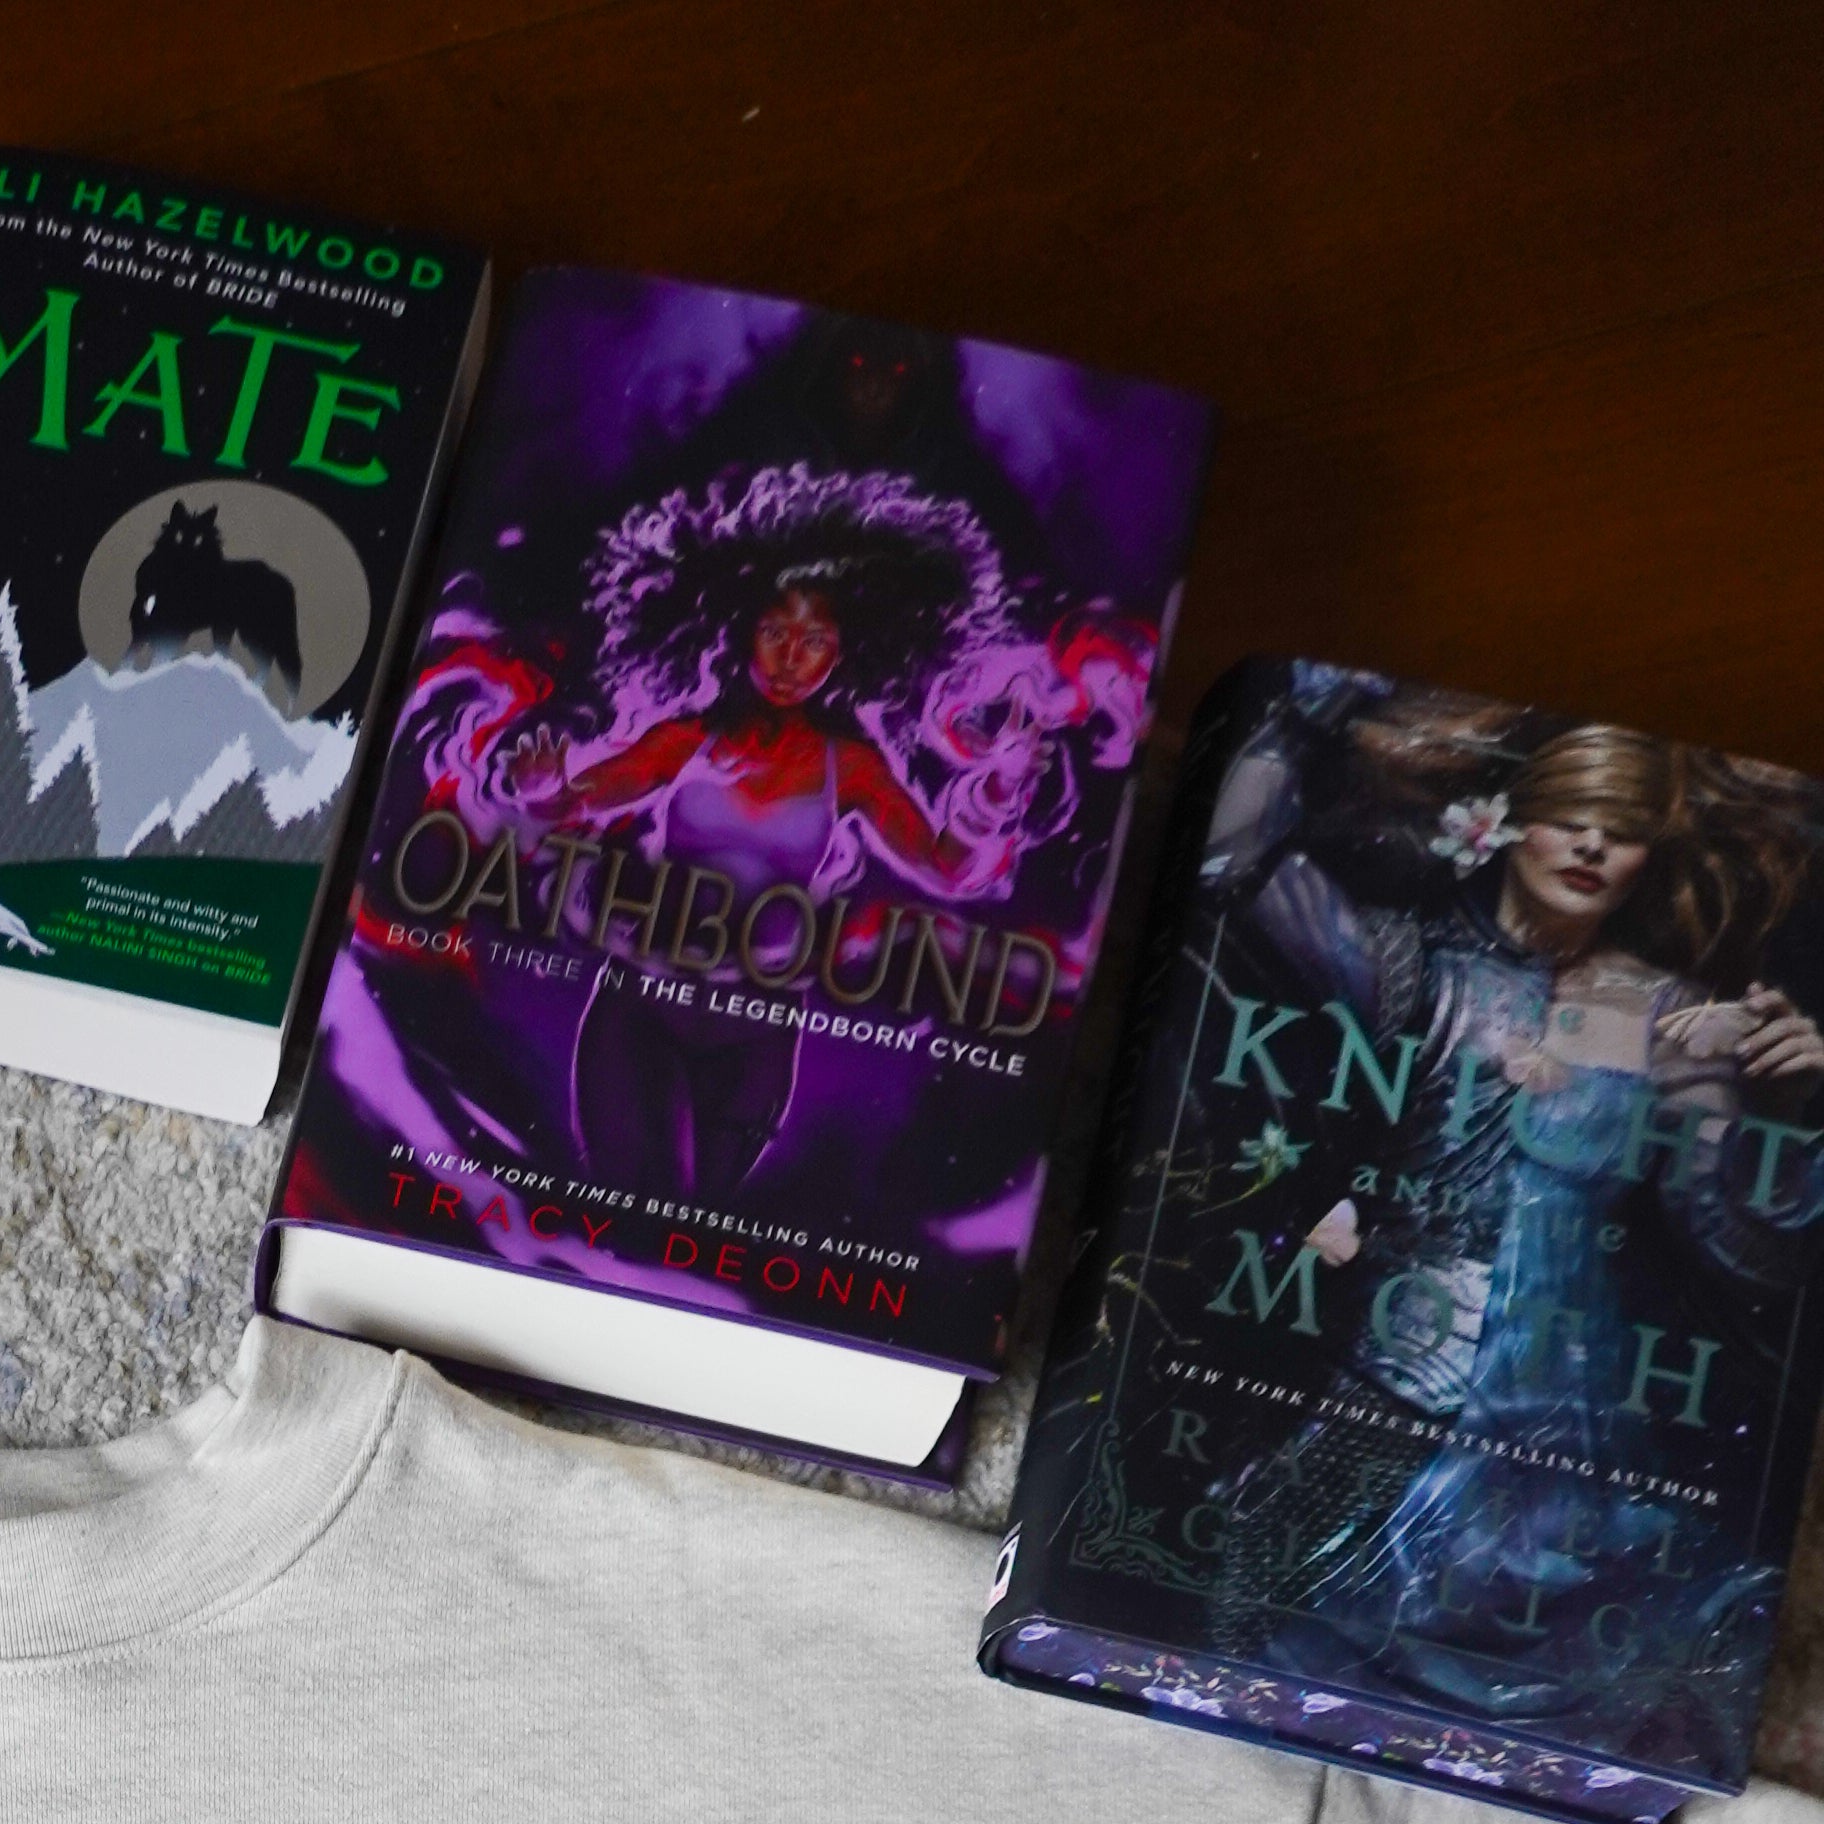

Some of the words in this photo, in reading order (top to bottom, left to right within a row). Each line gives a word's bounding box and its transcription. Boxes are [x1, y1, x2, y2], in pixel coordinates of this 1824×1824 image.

[37, 219, 71, 238] the
[83, 227, 133, 250] New
[146, 240, 192, 264] York
[206, 253, 268, 281] Times
[276, 270, 405, 317] Bestselling
[72, 181, 443, 288] HAZELWOOD
[84, 252, 162, 281] Author
[174, 274, 197, 289] of
[207, 280, 277, 307] BRIDE
[86, 898, 131, 915] primal
[134, 906, 145, 920] in
[150, 911, 165, 923] its
[104, 918, 137, 936] York
[141, 927, 184, 948] Times
[164, 899, 190, 912] and
[194, 905, 228, 924] witty
[232, 915, 258, 928] and
[391, 809, 1060, 1038] OATHBOUND
[384, 919, 474, 961] BOOK
[485, 939, 584, 981] THREE
[592, 964, 627, 990] IN
[641, 973, 695, 1005] THE
[708, 988, 918, 1054] LEGENDBORN
[929, 1038, 1025, 1075] CYCLE
[388, 1174, 613, 1251] TRACY
[661, 1233, 906, 1317] DEONN
[391, 1144, 417, 1161] #1
[424, 1149, 481, 1177] NEW
[490, 1165, 554, 1190] YORK
[567, 1181, 635, 1208] TIMES
[646, 1199, 807, 1246] BESTSELLING
[819, 1238, 919, 1270] AUTHOR
[1167, 1361, 1222, 1384] NEW
[1237, 1378, 1304, 1405] YORK
[1407, 1418, 1597, 1479] BESTSELLING
[1608, 1469, 1717, 1505] AUTHOR
